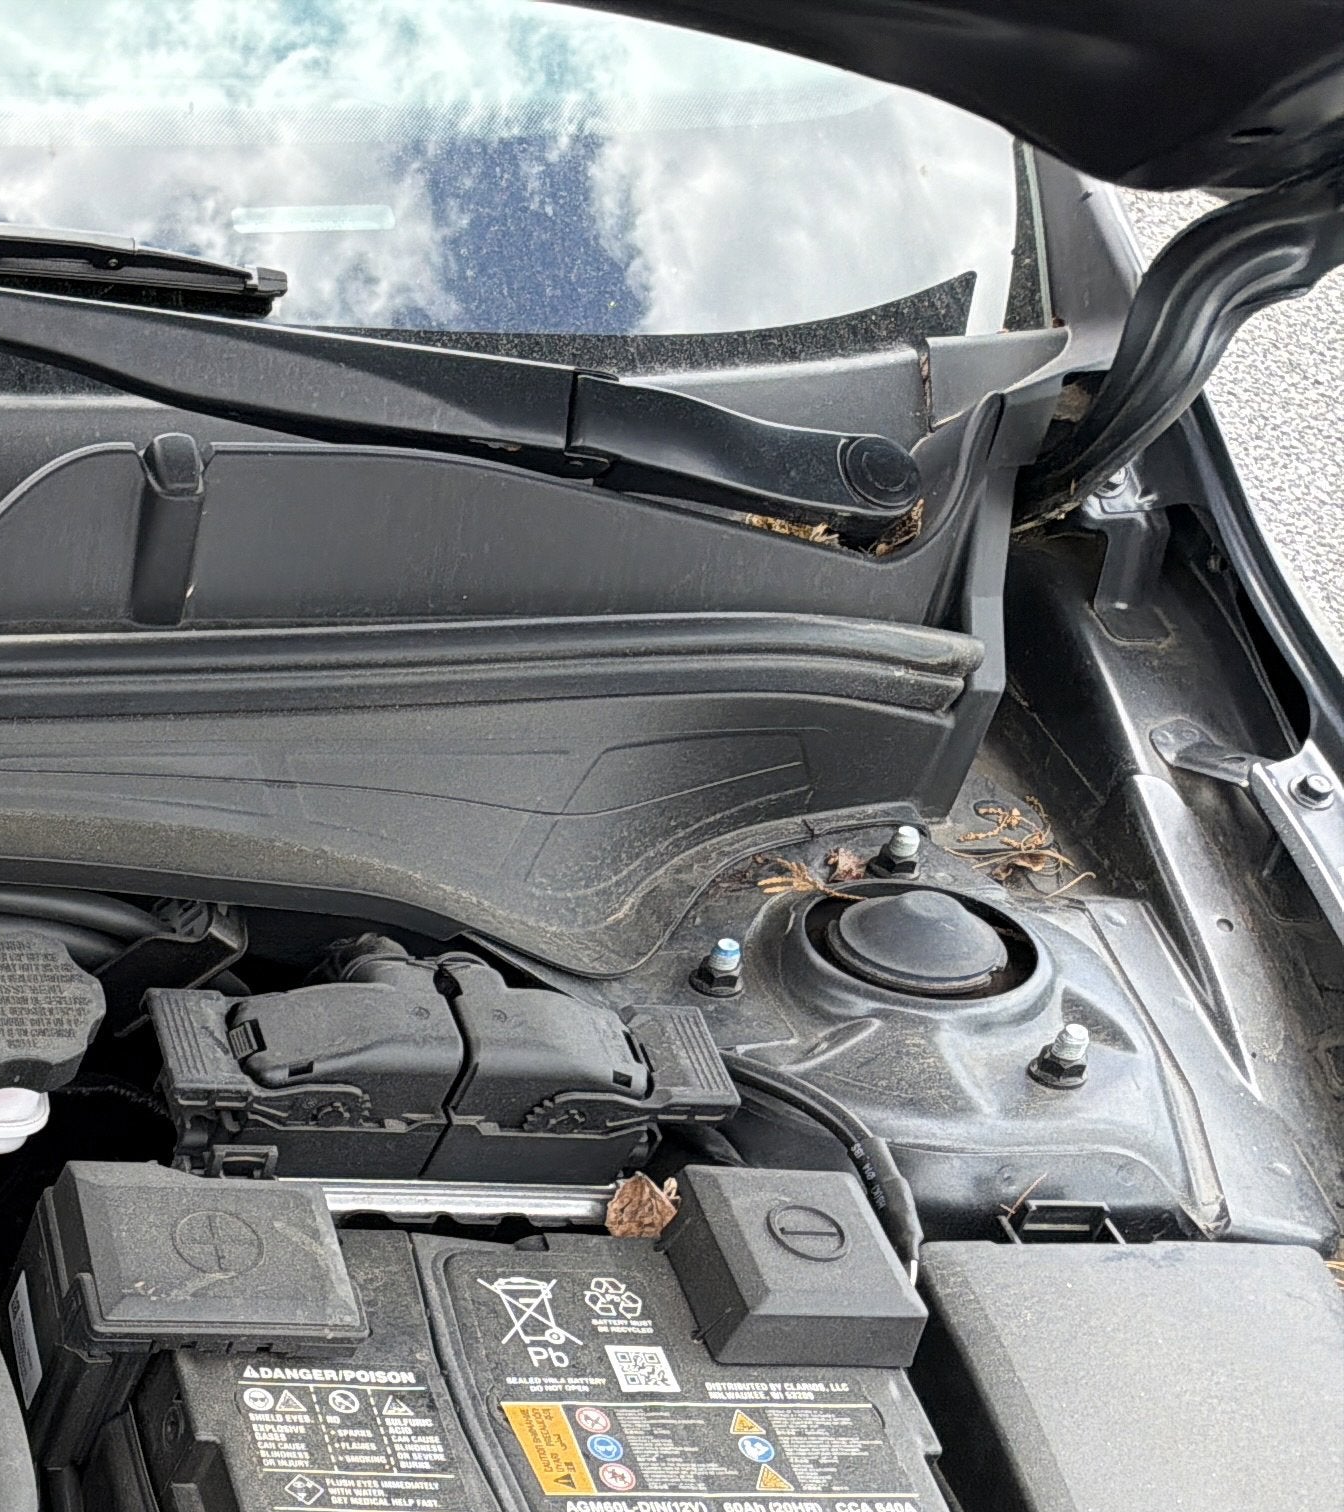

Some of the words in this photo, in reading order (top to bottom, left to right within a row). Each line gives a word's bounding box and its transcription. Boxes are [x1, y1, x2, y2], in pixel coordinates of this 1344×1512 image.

[592, 1319, 628, 1327] BATTERY
[630, 1319, 652, 1327] MUST
[611, 1326, 654, 1334] RECYCLED
[527, 1347, 570, 1368] Pb
[259, 1367, 416, 1384] DANGER/POISON
[506, 1377, 541, 1385] SEALED
[567, 1377, 606, 1386] BATTERY
[530, 1385, 543, 1393] DO
[545, 1385, 563, 1393] NOT
[565, 1385, 590, 1393] OPEN
[705, 1381, 768, 1392] DISTRIBUTED
[769, 1382, 782, 1392] BY
[830, 1382, 850, 1392] LLC
[249, 1413, 283, 1423] SHIELD
[326, 1416, 341, 1425] NO
[385, 1418, 433, 1427] SULFURIC
[252, 1424, 306, 1434] EXPLOSIVE
[337, 1429, 373, 1438] SPARKS
[388, 1426, 413, 1435] ACID
[255, 1433, 287, 1442] GASES
[391, 1435, 412, 1444] CAN
[413, 1436, 441, 1444] CAUSE
[257, 1442, 276, 1450] CAN
[278, 1442, 306, 1451] CAUSE
[341, 1443, 377, 1451] FLAMES
[394, 1444, 443, 1453] BLINDNESS
[260, 1450, 310, 1460] BLINDNESS
[344, 1455, 387, 1464] SMOKING
[397, 1453, 410, 1461] OR
[412, 1453, 446, 1462] SEVERE
[263, 1458, 275, 1467] OR
[325, 1478, 355, 1488] FLUSH
[356, 1479, 379, 1489] EYES
[381, 1480, 439, 1491] IMMEDIATELY
[328, 1487, 356, 1497] WITH
[331, 1496, 349, 1505] GET
[350, 1497, 390, 1506] MEDICAL
[391, 1498, 415, 1507] HELP
